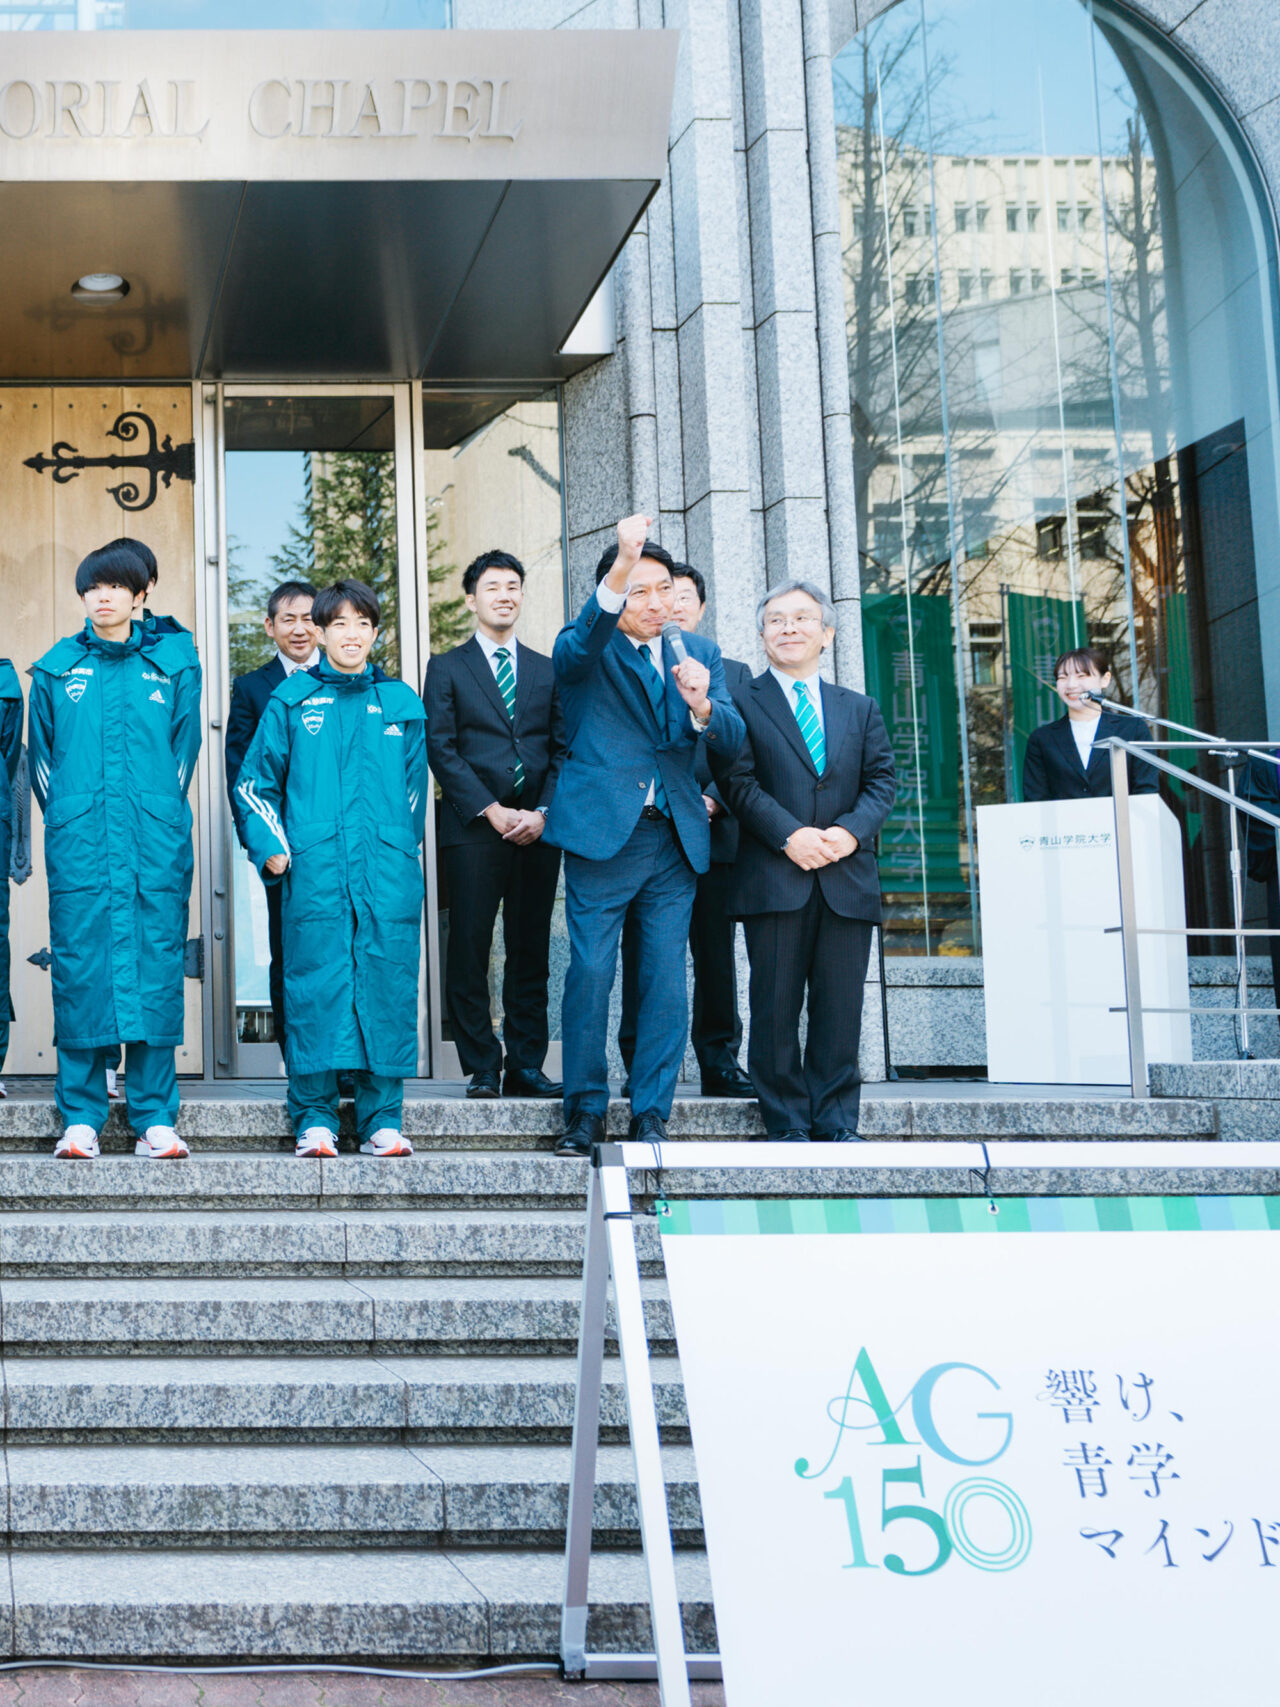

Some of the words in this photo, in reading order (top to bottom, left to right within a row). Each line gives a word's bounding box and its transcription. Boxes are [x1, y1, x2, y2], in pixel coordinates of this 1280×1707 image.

[247, 76, 522, 143] CHAPEL
[1039, 833, 1111, 846] 青山学院大学
[794, 1346, 1013, 1479] AG
[1036, 1368, 1184, 1424] 響け、
[1062, 1442, 1181, 1498] 青学
[823, 1454, 1032, 1577] 150
